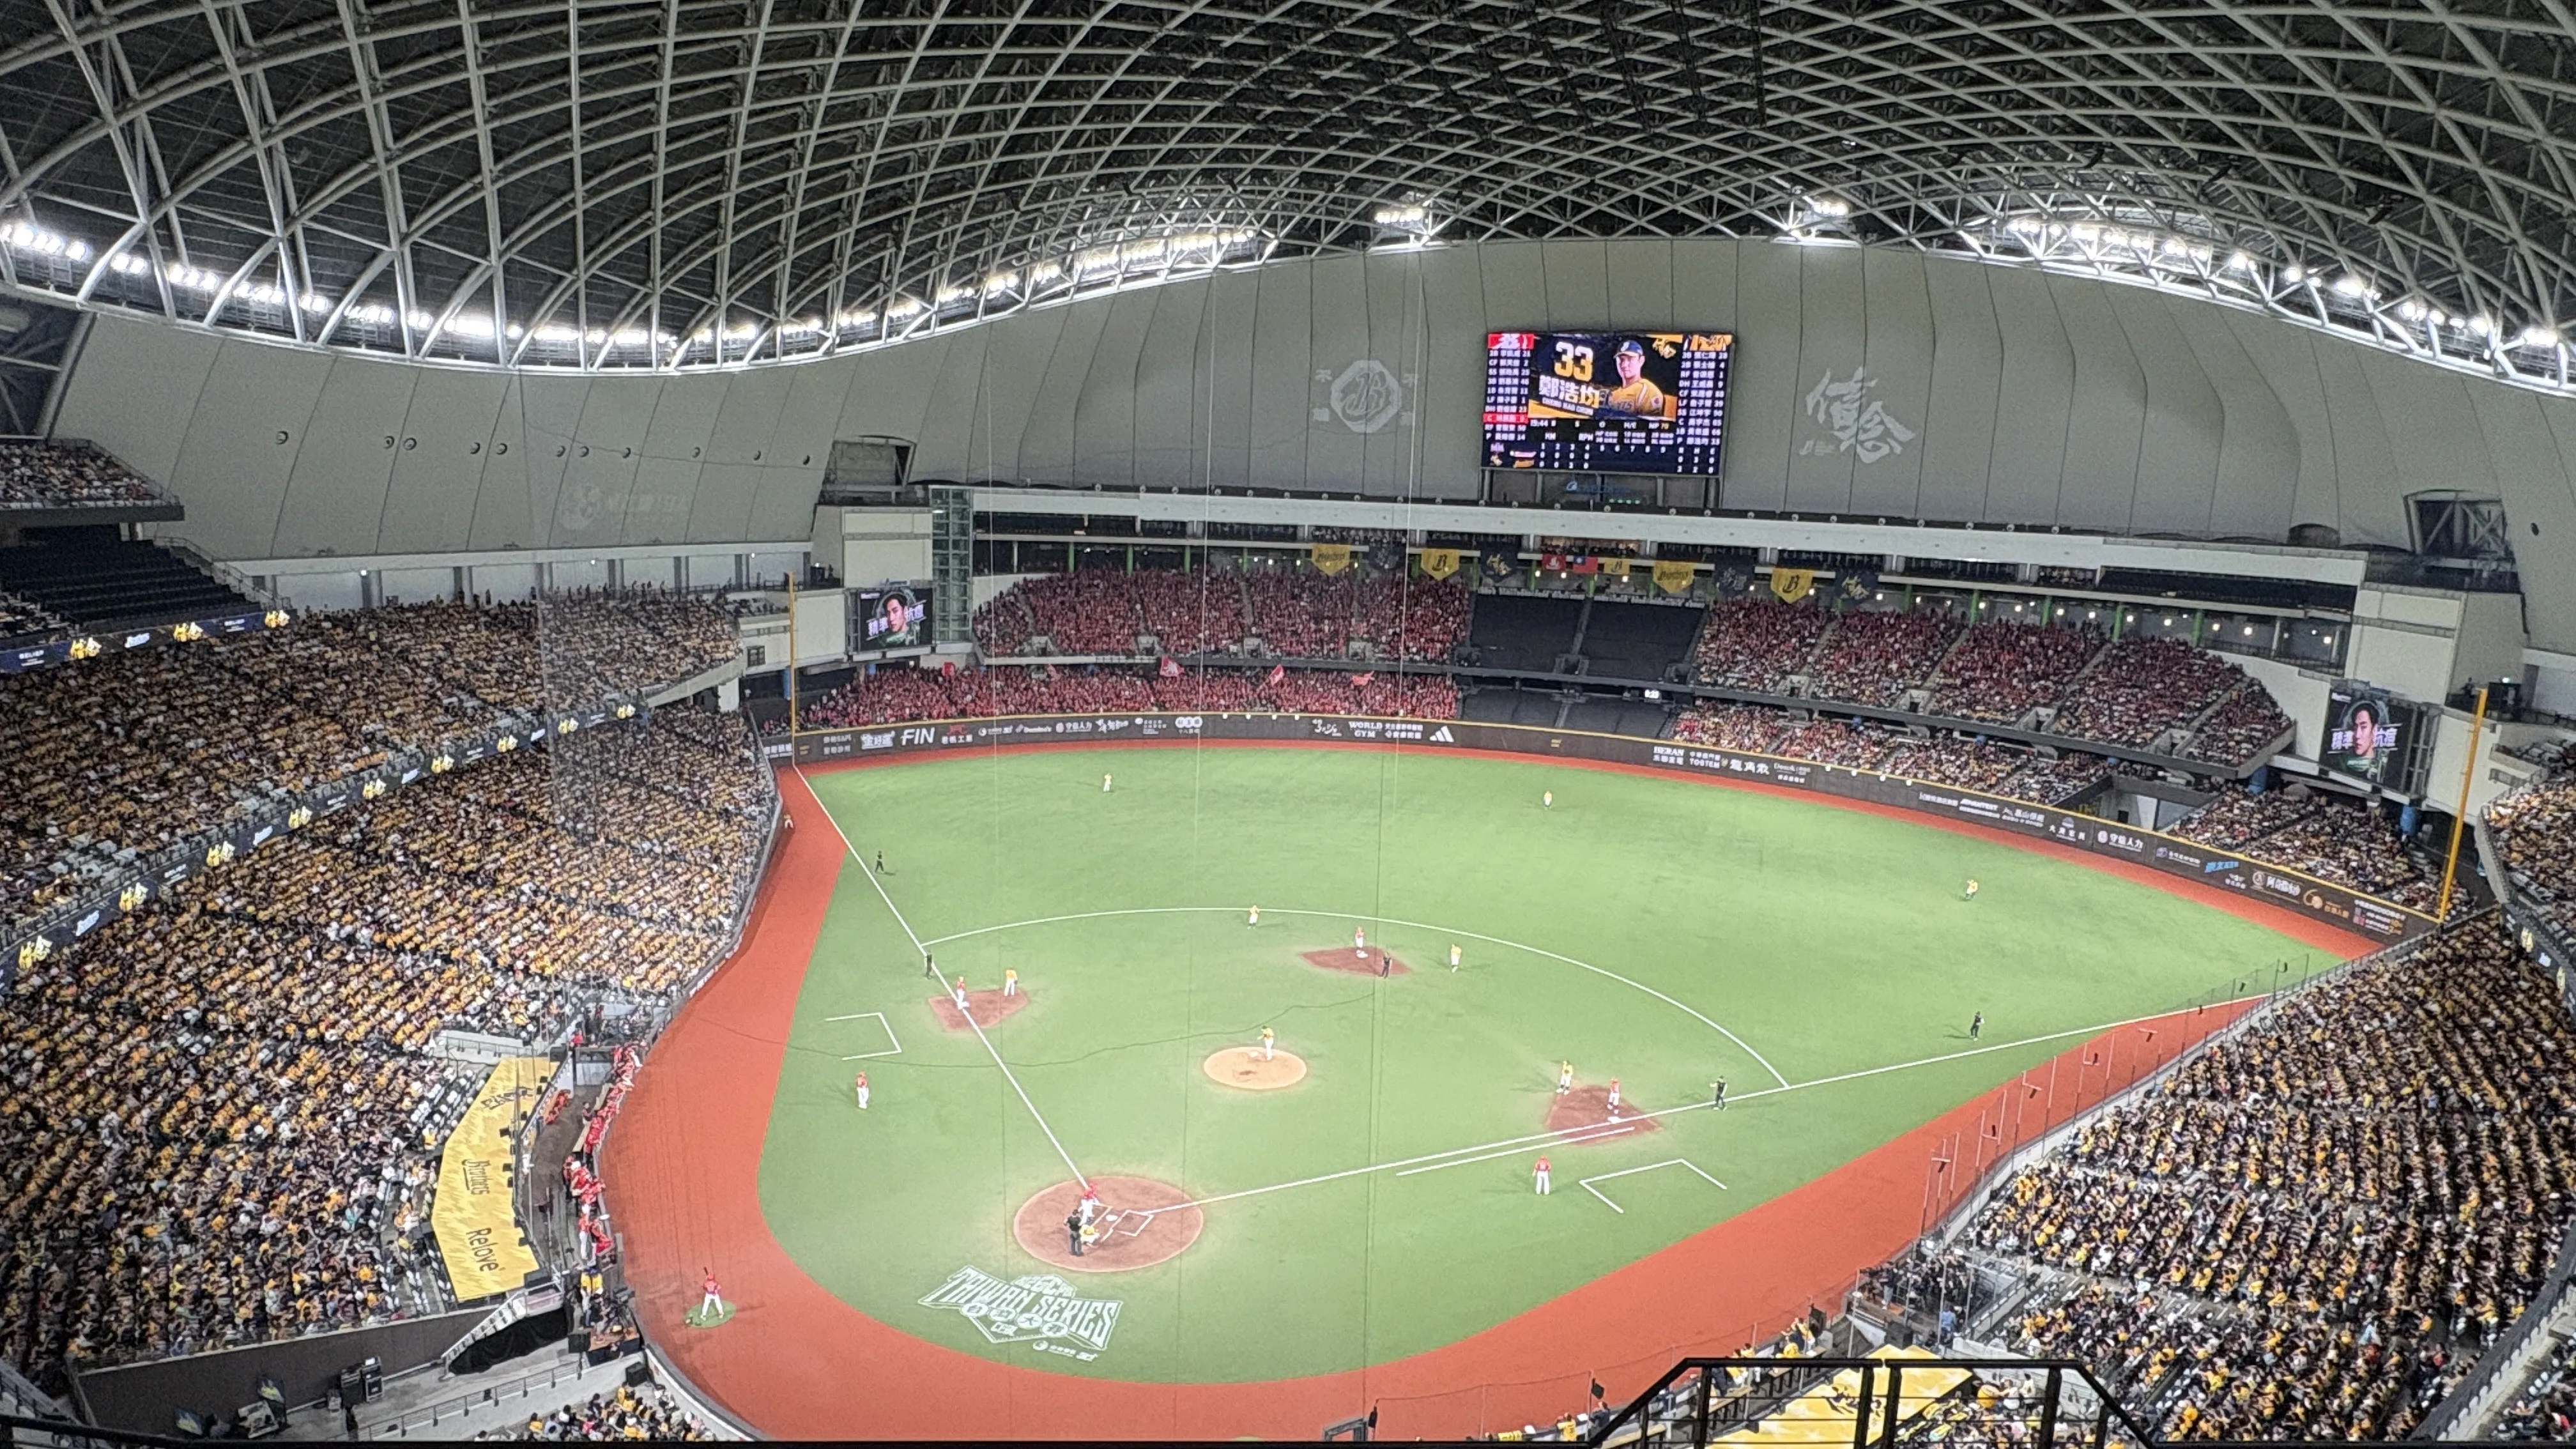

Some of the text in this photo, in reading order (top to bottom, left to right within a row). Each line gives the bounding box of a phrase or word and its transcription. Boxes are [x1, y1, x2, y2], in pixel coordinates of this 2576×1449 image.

[1554, 341, 1593, 382] 33
[1349, 721, 1383, 730] WORLD
[1354, 730, 1376, 739] GYM
[900, 727, 935, 746] FIN
[924, 1266, 1038, 1316] TAIWAN
[1032, 1294, 1119, 1349] SERIES
